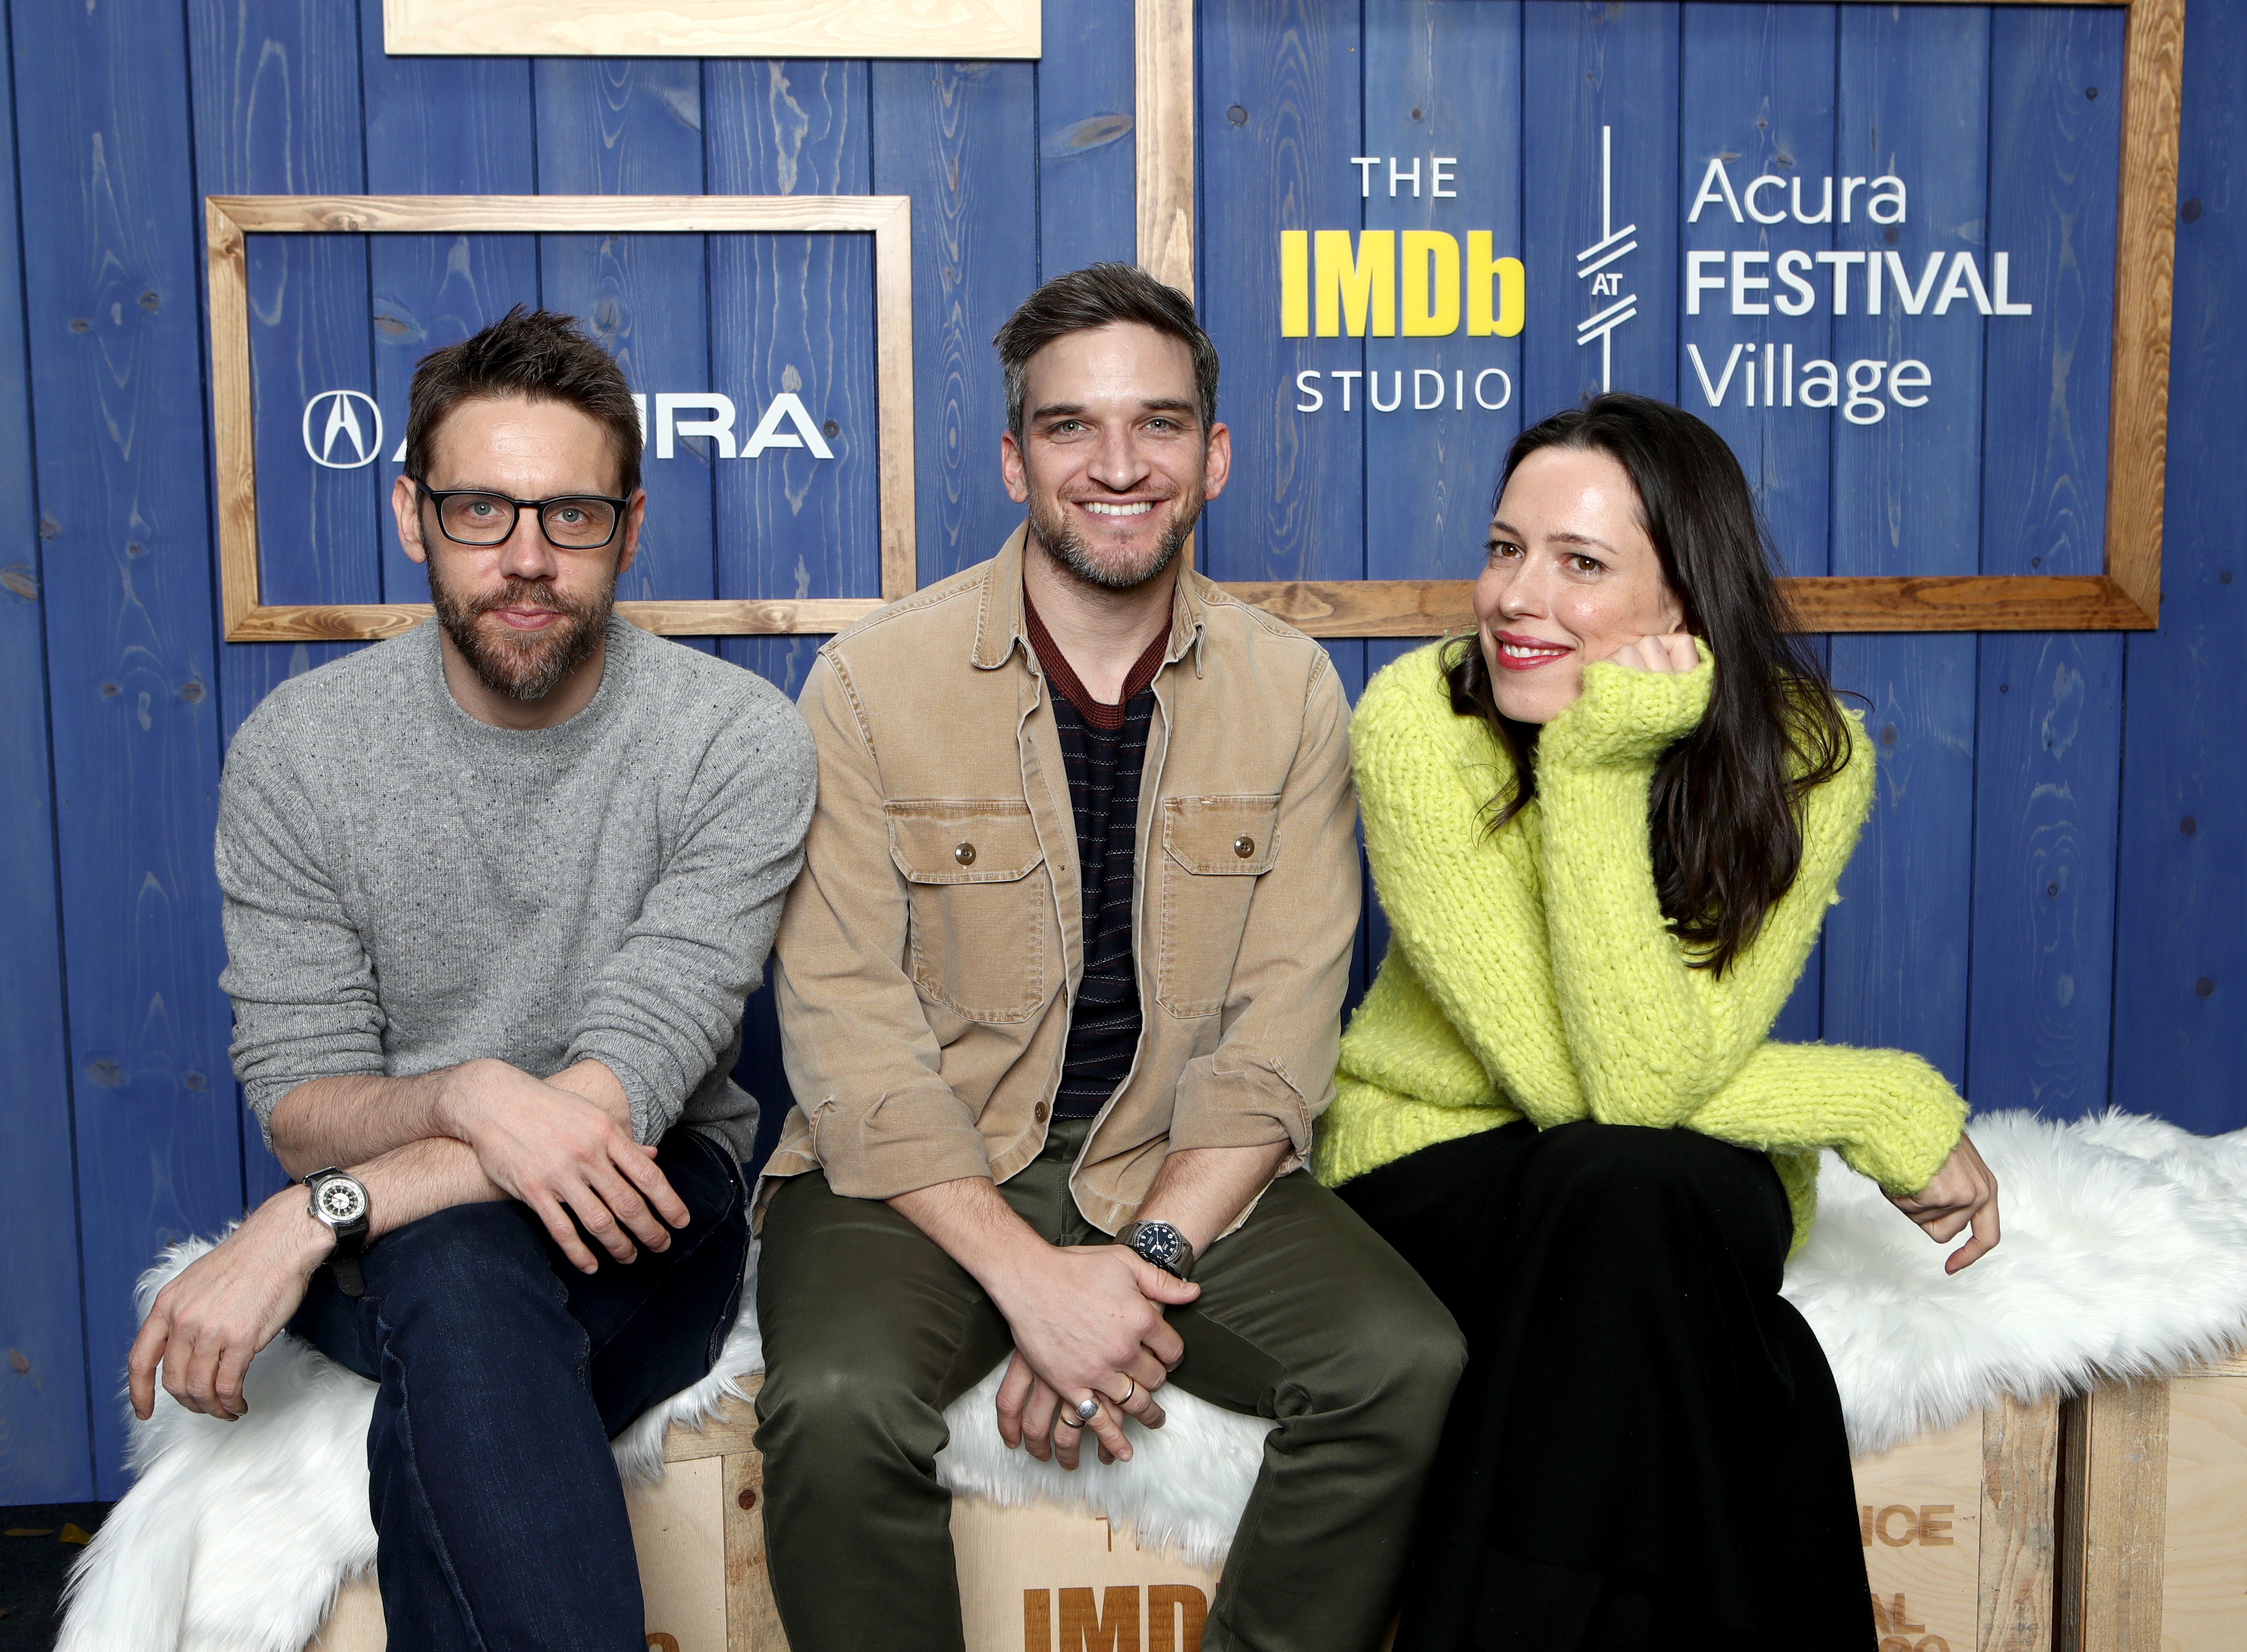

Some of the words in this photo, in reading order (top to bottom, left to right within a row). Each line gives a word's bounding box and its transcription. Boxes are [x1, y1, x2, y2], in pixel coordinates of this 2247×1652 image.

[1350, 153, 1457, 198] THE
[1688, 158, 1906, 225] Acura
[1281, 231, 1526, 338] IMDb
[1591, 273, 1624, 296] AT
[1686, 251, 2033, 316] FESTIVAL
[1296, 368, 1512, 413] STUDIO
[1686, 343, 1932, 425] Village
[1023, 1583, 1220, 1652] IMD
